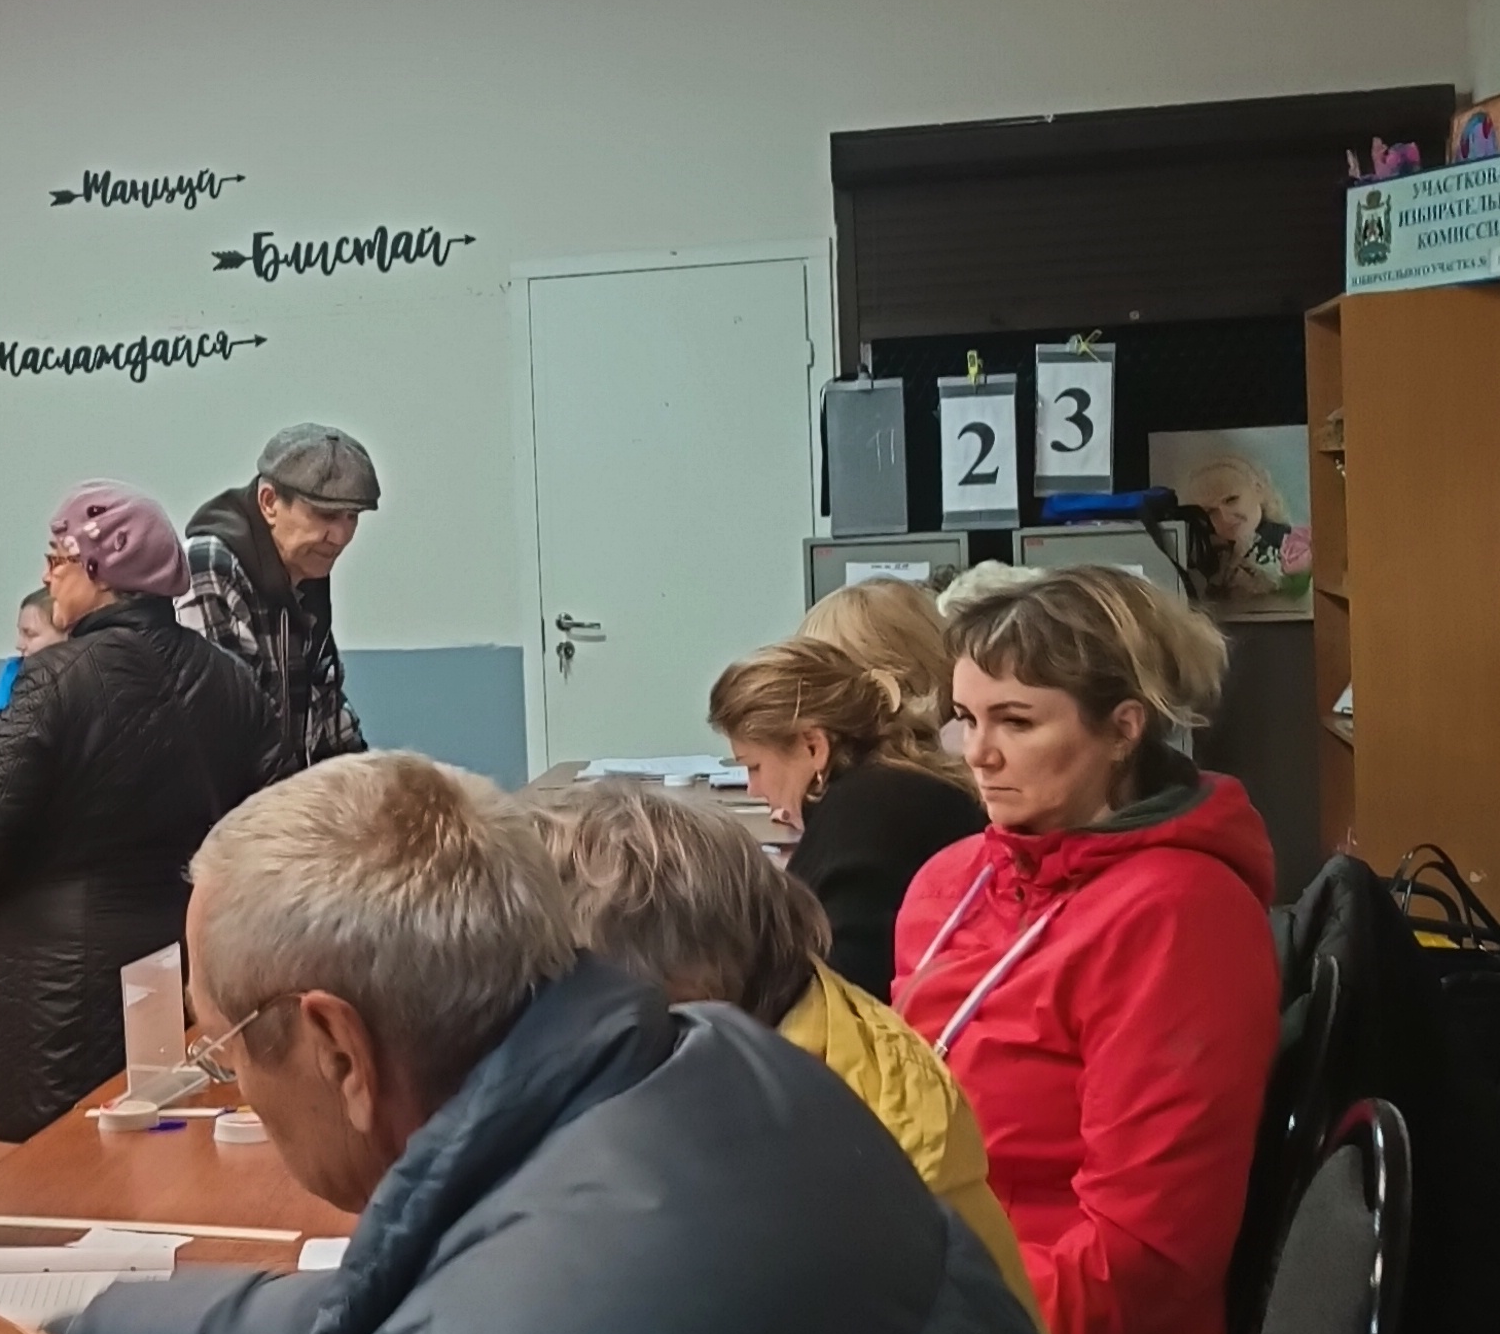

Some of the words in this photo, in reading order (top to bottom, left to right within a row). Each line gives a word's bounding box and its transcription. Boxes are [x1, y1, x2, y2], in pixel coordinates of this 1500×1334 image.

[83, 168, 222, 210] Танцуй
[1412, 167, 1500, 199] УЧАСТКОВ
[1398, 193, 1500, 227] ИЗБИРАТЕЛЬ
[252, 225, 450, 282] Блистай
[1050, 387, 1094, 453] 3
[957, 421, 1000, 486] 2
